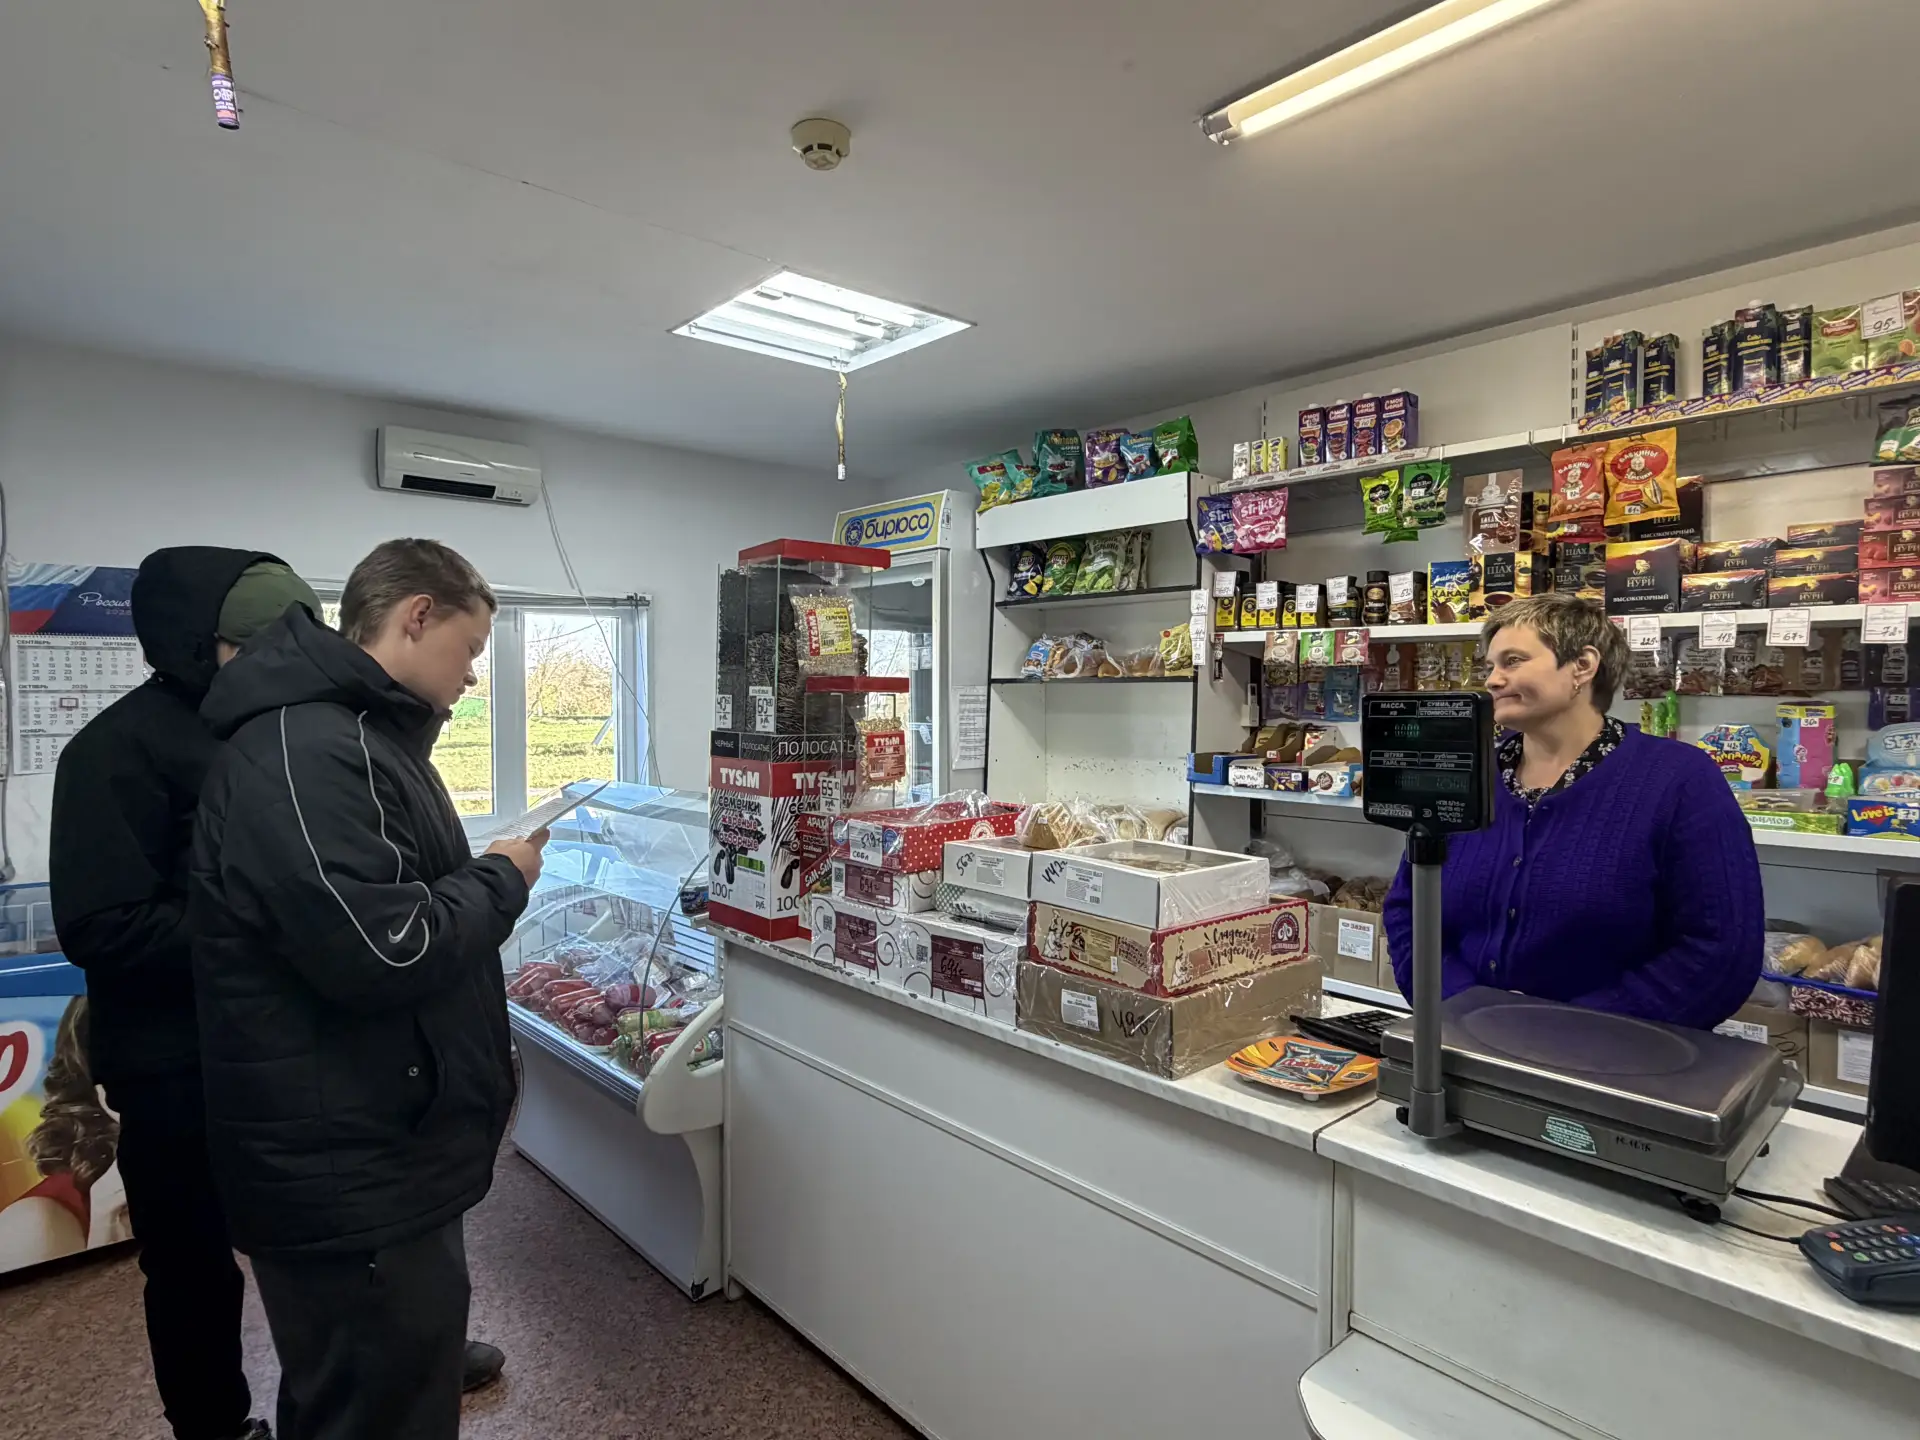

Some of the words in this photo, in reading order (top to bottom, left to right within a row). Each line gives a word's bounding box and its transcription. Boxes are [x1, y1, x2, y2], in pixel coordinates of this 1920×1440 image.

[1618, 450, 1659, 464] БАБКИНЫ
[1723, 559, 1748, 568] НУРИ
[1805, 564, 1830, 572] НУРИ
[1487, 564, 1513, 576] ШАХ
[1556, 574, 1579, 583] ШАХ
[1626, 578, 1655, 588] НУРИ
[78, 591, 130, 606] Россия
[1612, 594, 1669, 603] ВЫСОКОГОРНЫЙ
[1709, 592, 1735, 601] НУРИ
[1799, 591, 1824, 601] НУРИ
[1851, 809, 1882, 821] Love
